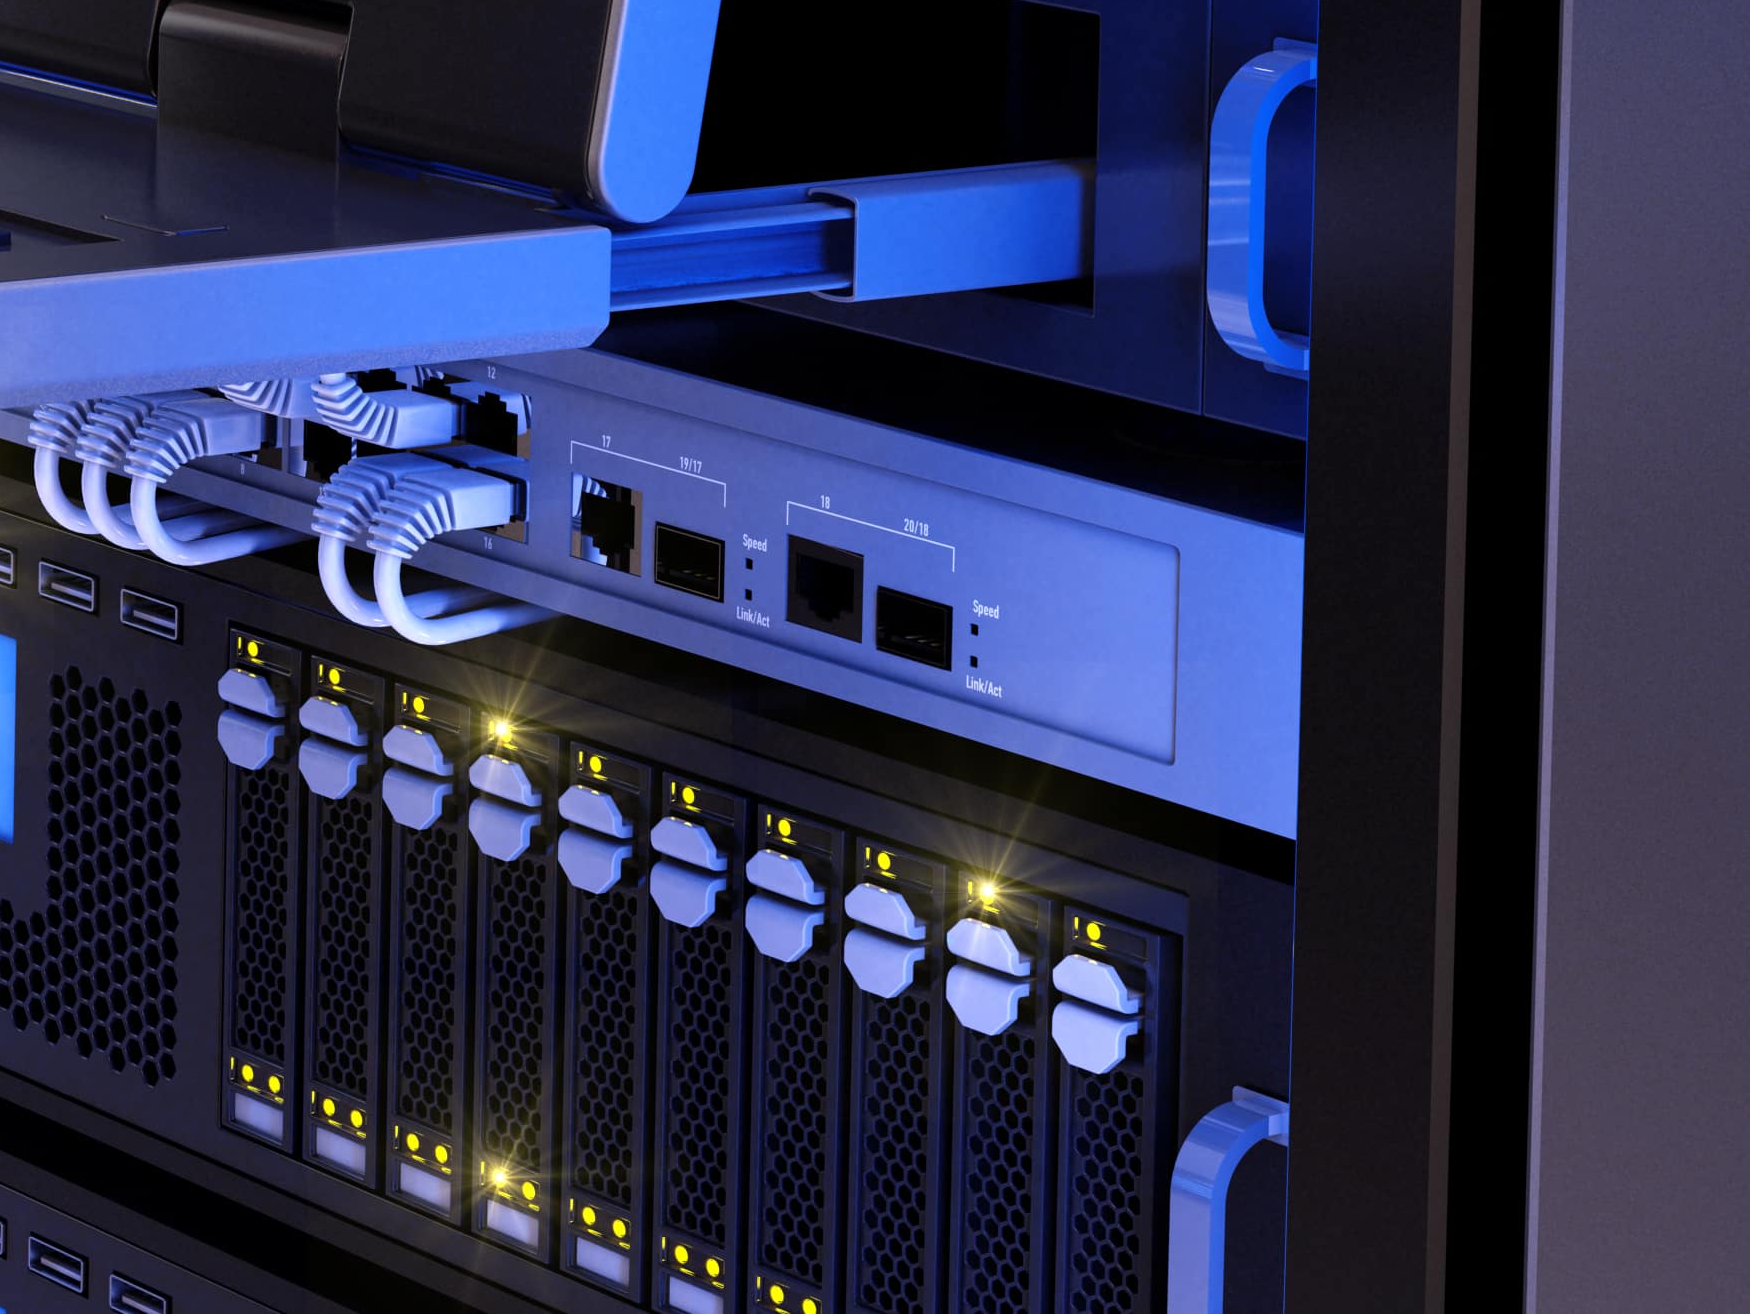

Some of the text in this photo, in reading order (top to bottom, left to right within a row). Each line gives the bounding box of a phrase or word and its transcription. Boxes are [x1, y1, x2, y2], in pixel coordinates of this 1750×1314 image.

[487, 365, 496, 379] 12
[600, 434, 611, 451] 17
[677, 456, 702, 474] 19/17
[819, 495, 830, 513] 18
[902, 518, 929, 539] 20/18
[484, 536, 493, 550] 16
[742, 533, 767, 552] Speed
[736, 606, 770, 628] Link/Act
[973, 599, 1000, 619] Speed
[966, 675, 1002, 698] Link/Act
